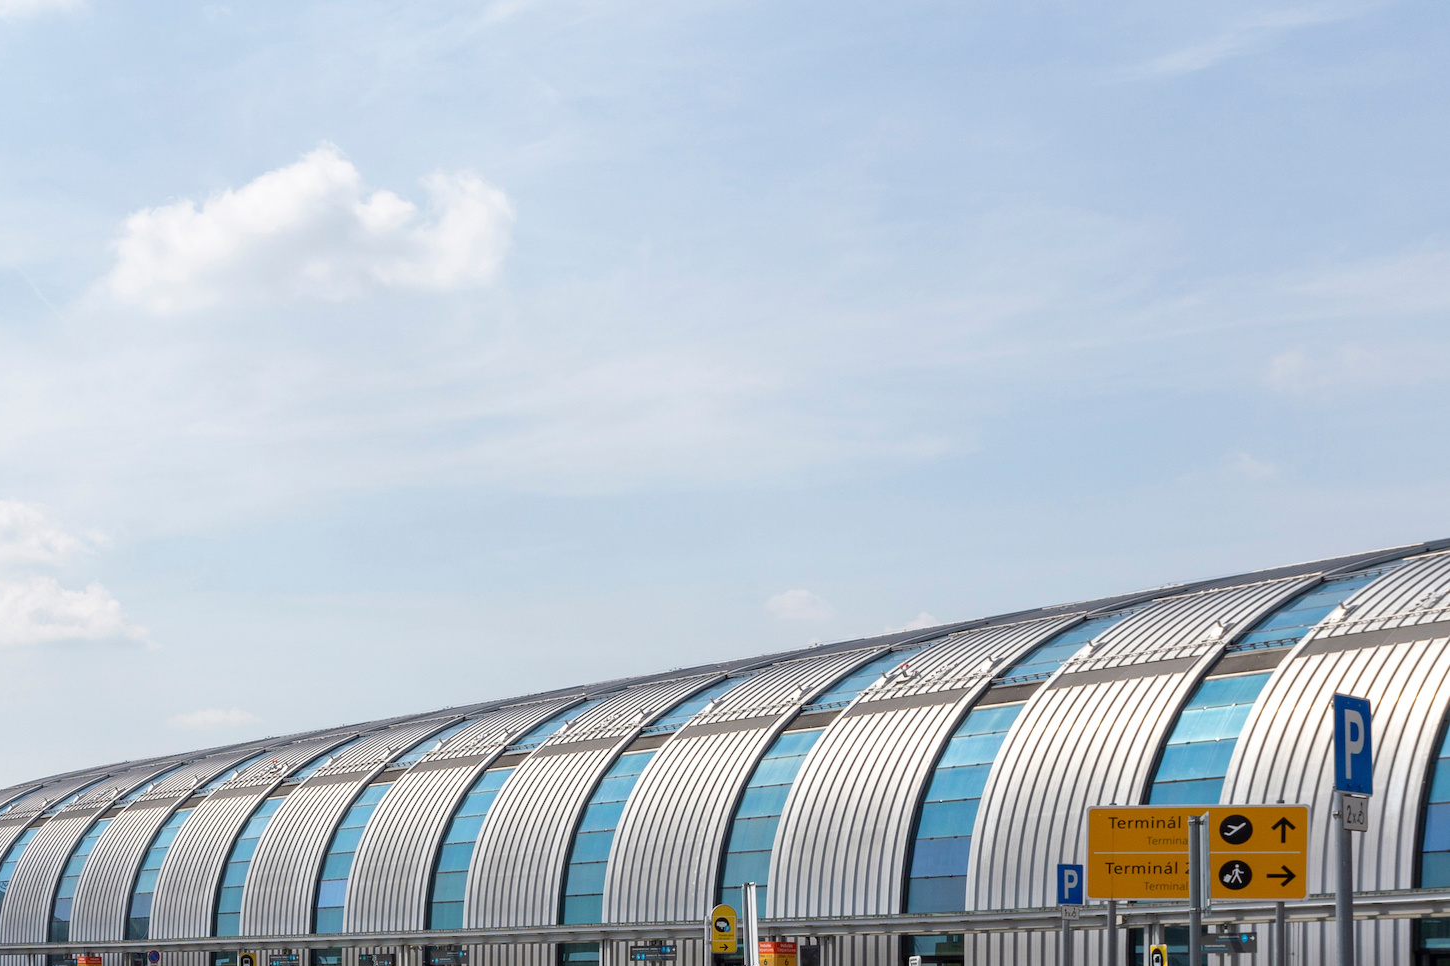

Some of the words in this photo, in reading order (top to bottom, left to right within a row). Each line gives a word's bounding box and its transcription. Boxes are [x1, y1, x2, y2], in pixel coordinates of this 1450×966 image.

[1344, 708, 1365, 780] P
[1108, 816, 1181, 829] Terminál
[1105, 862, 1178, 875] Terminál
[1063, 869, 1079, 900] P
[1144, 882, 1189, 891] Terminal
